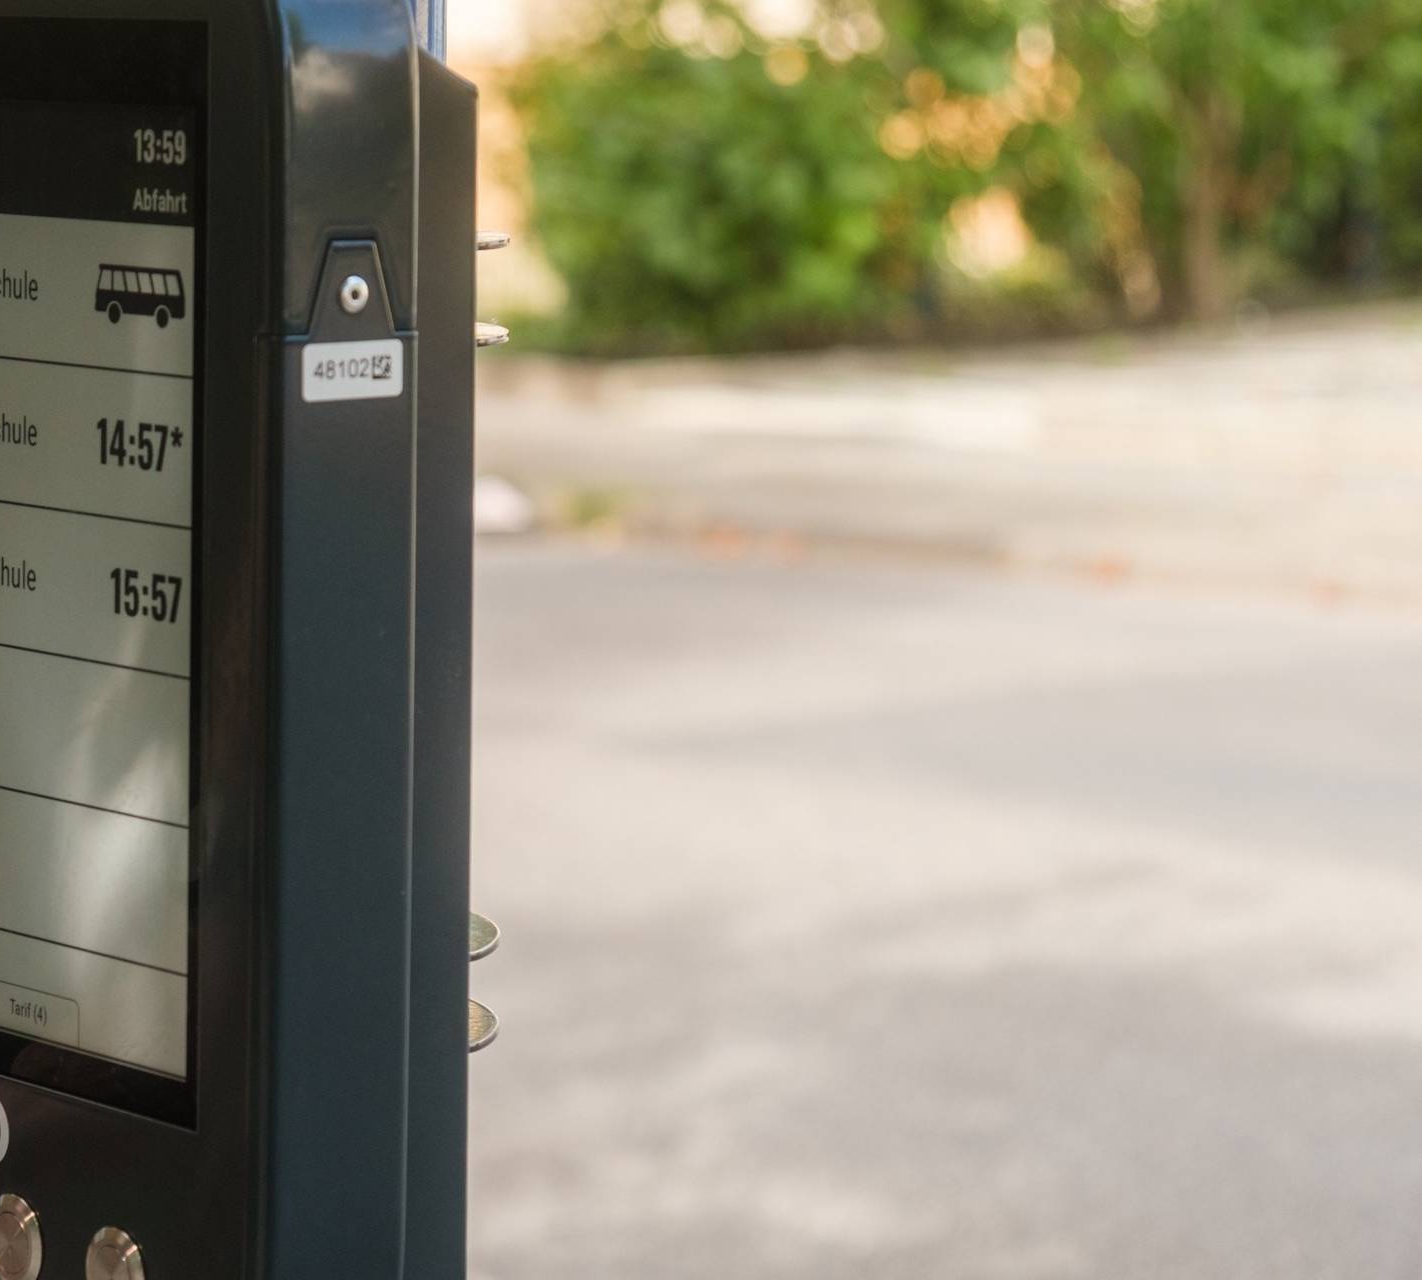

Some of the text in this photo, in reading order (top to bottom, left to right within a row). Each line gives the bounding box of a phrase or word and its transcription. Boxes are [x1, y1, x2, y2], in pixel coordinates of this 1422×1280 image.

[134, 128, 187, 165] 13:59
[133, 188, 187, 214] Abfahrt
[314, 358, 369, 380] 48102
[110, 567, 182, 623] 15:57
[10, 998, 47, 1026] Tarif (4)
